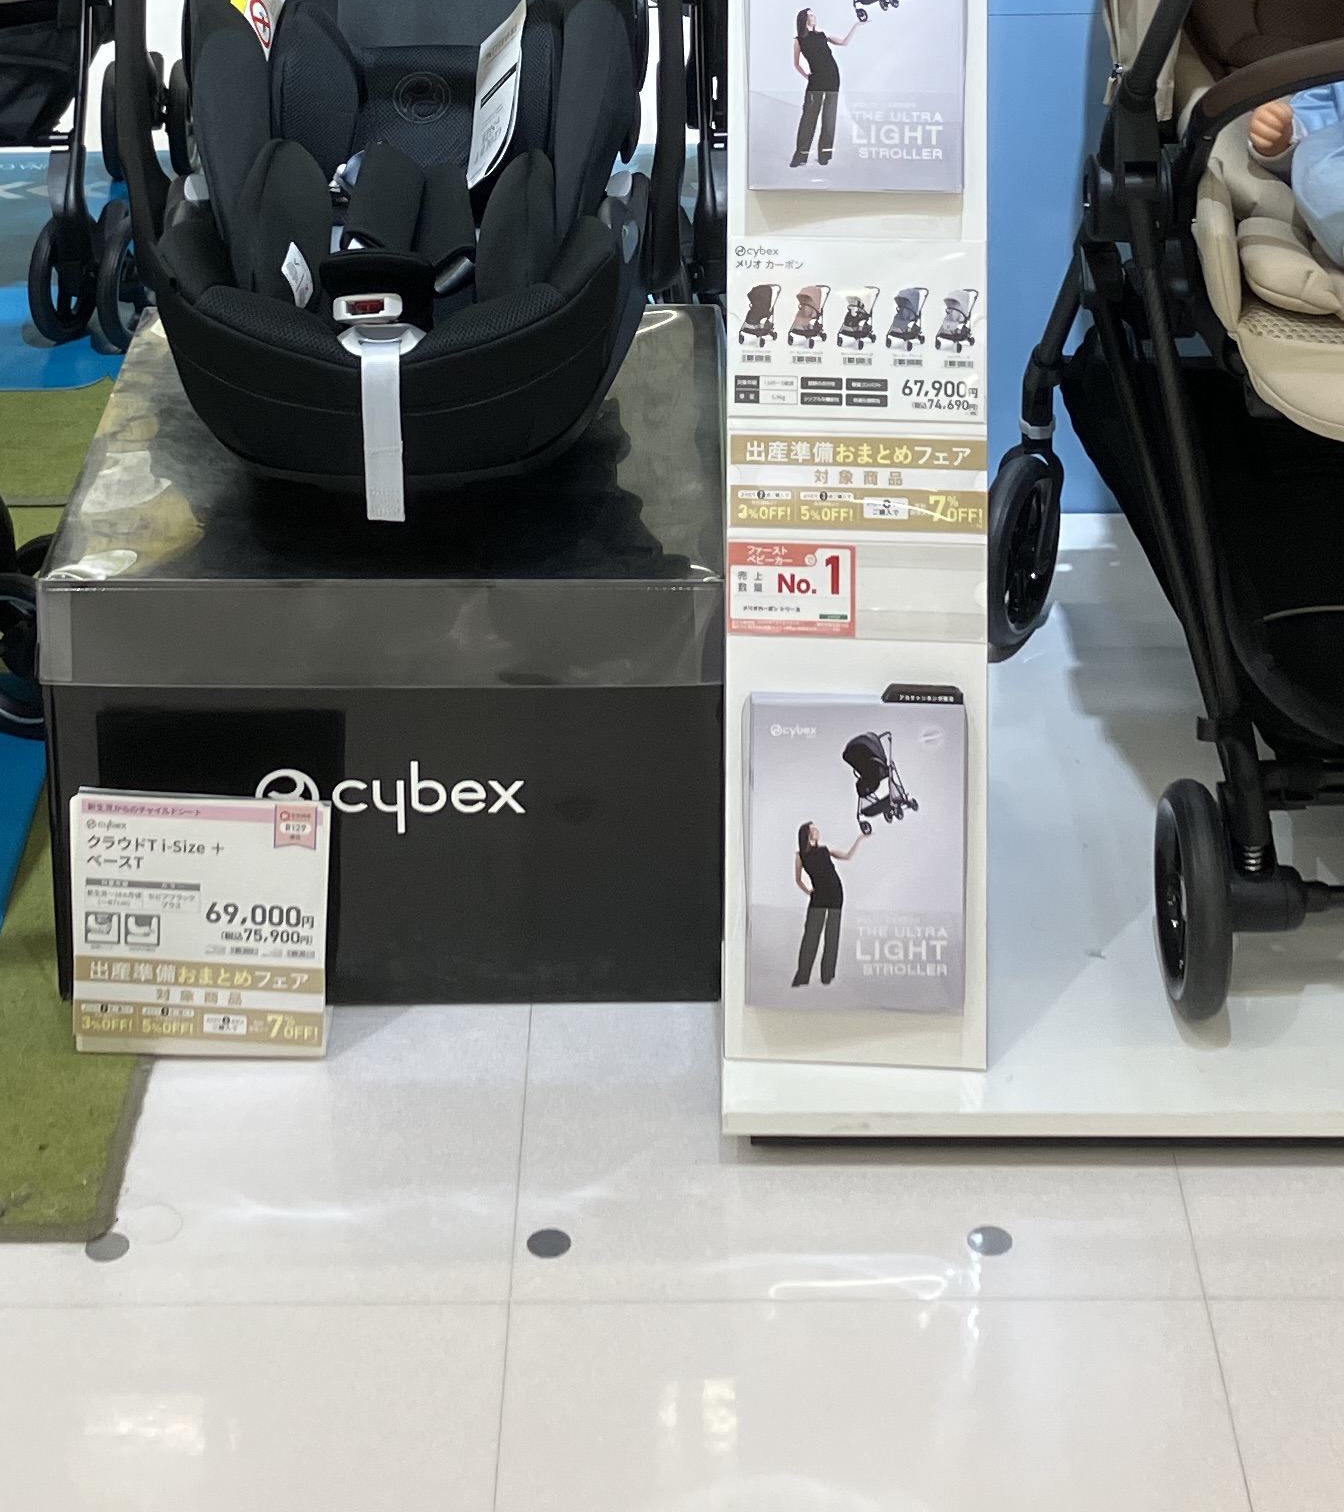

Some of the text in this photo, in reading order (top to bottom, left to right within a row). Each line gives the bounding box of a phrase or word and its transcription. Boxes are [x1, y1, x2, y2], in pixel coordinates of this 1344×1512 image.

[853, 111, 943, 123] THE ULTRA
[852, 125, 943, 145] LIGHT
[858, 148, 943, 160] STROLLER
[747, 245, 779, 257] cybex
[746, 441, 971, 466] 出産準備おまとめフェア
[783, 725, 817, 737] cybex
[331, 760, 526, 835] cybex
[206, 902, 315, 929] 69,000円
[856, 941, 947, 961] LIGHT
[89, 961, 309, 990] 出産準備おまとめフェア
[863, 963, 947, 976] STROLLER
